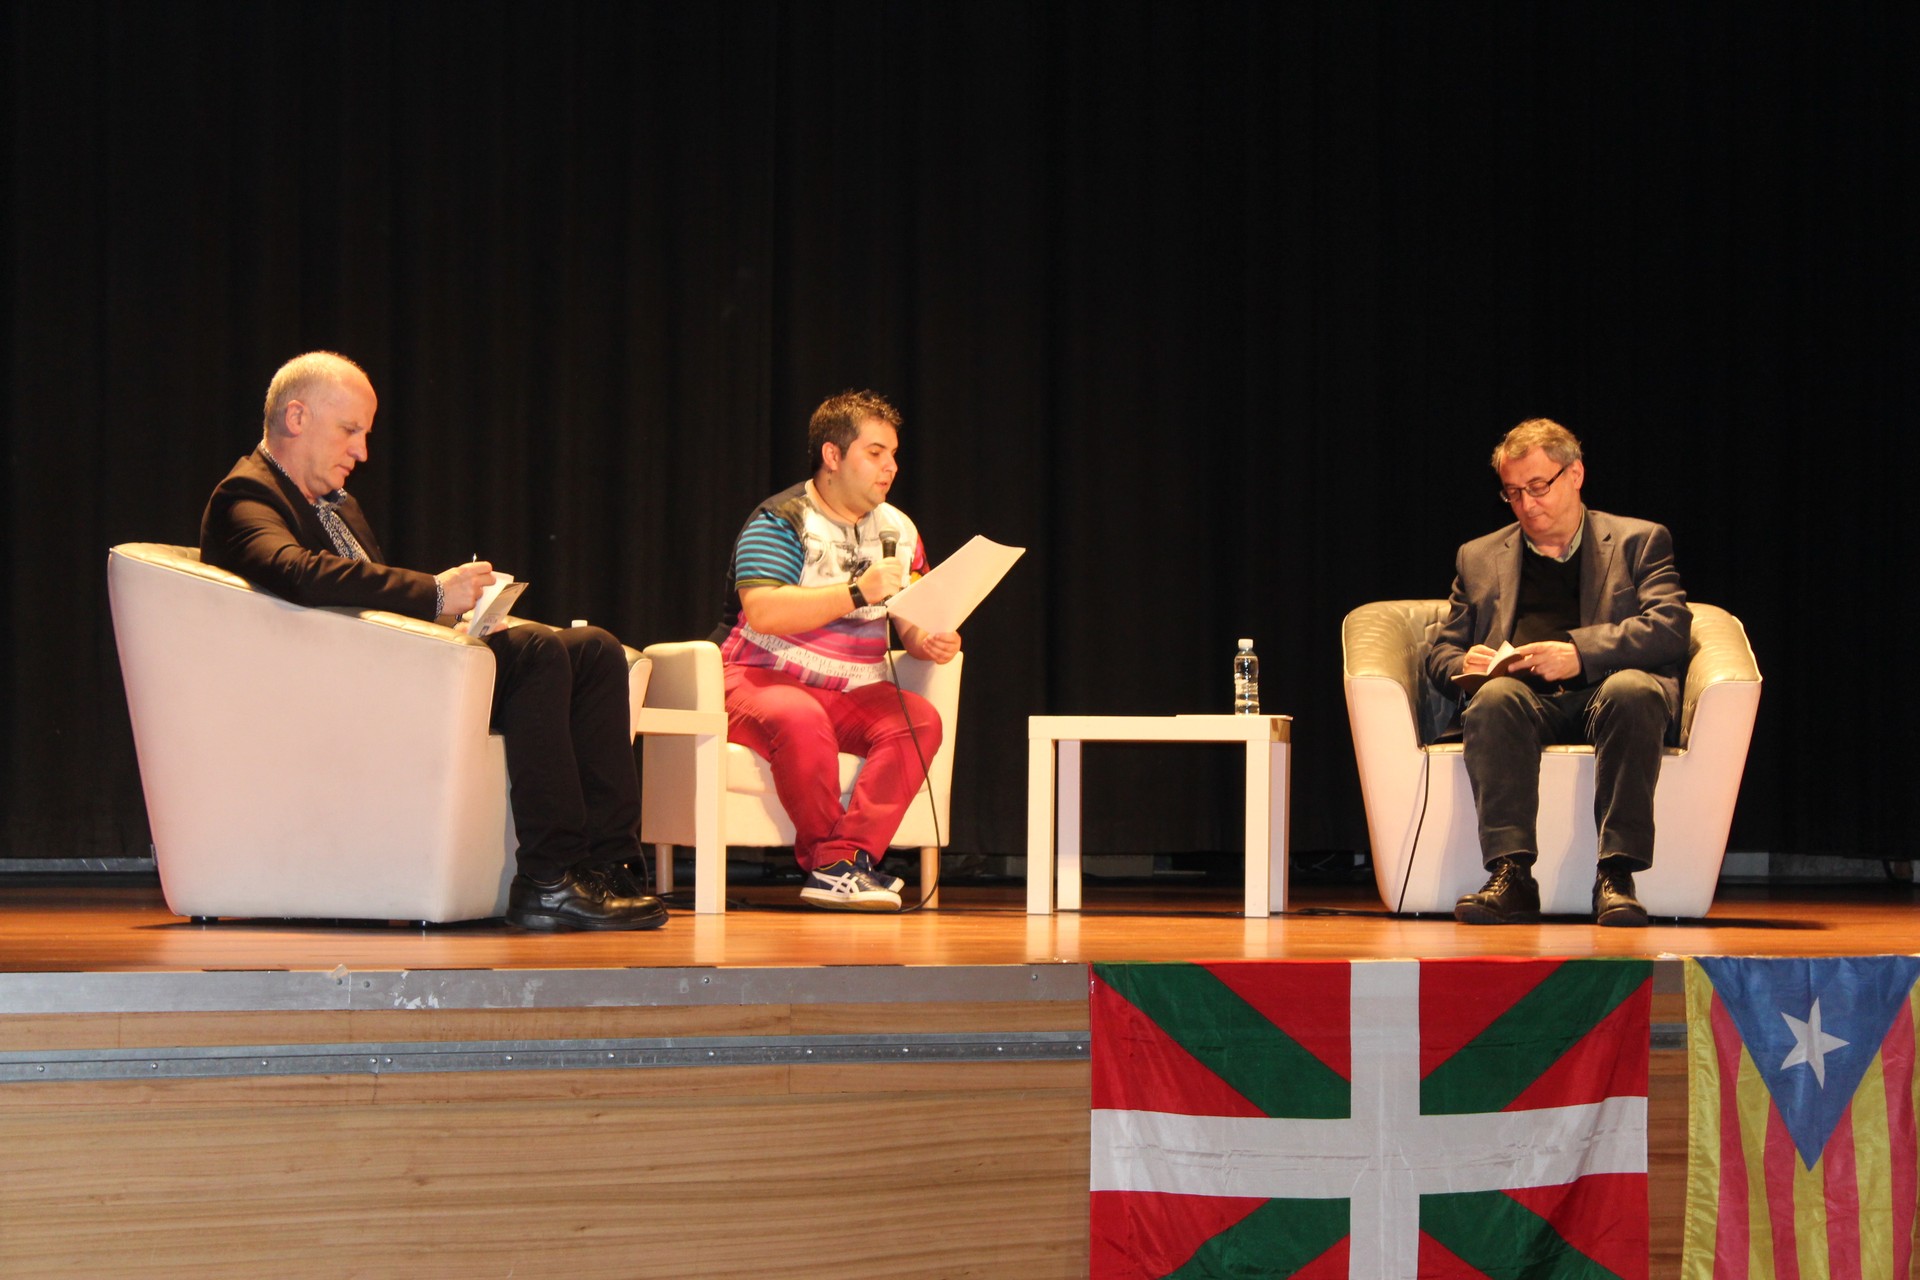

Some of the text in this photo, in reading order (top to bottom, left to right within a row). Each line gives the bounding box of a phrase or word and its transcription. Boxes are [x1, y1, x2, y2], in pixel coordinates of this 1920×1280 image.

[760, 640, 777, 652] the
[783, 652, 809, 666] next
[818, 663, 862, 678] London
[796, 649, 832, 666] about
